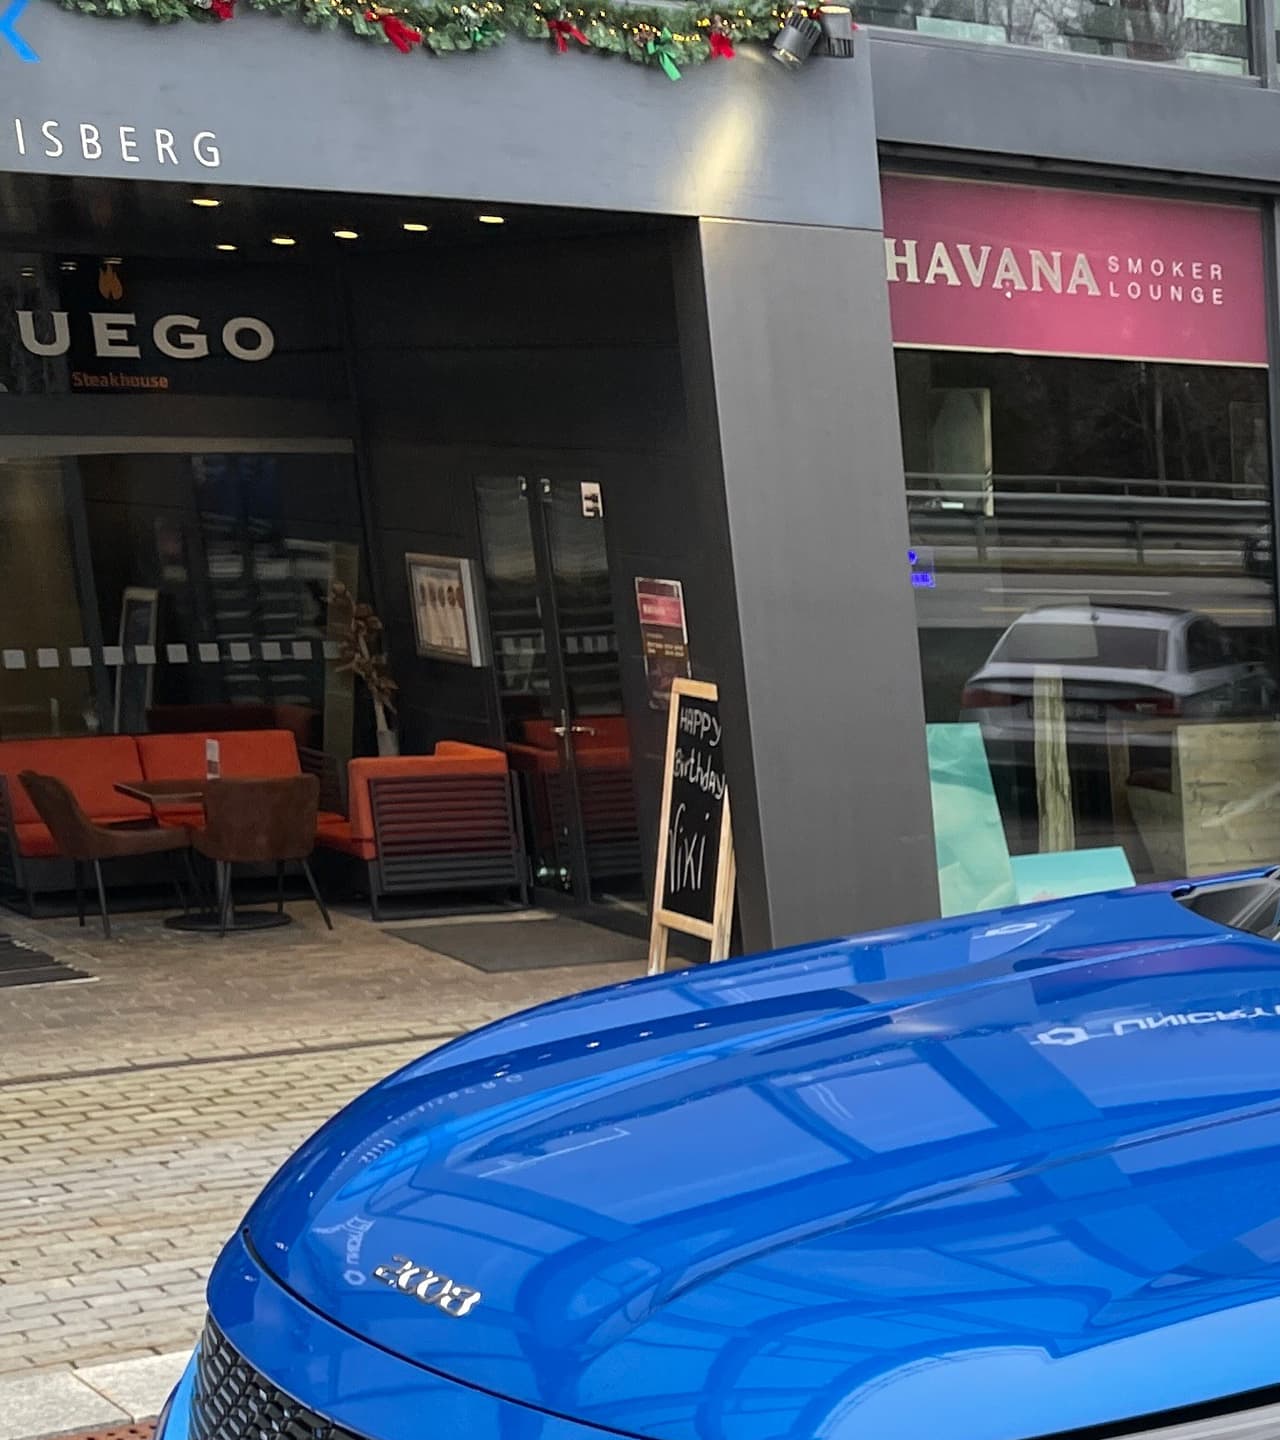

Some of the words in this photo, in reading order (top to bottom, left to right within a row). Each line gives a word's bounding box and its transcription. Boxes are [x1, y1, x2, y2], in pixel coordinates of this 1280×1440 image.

[15, 118, 221, 168] ISBERG
[884, 237, 1102, 297] HAVANA
[1108, 255, 1223, 281] SMOKER
[1109, 278, 1224, 305] LOUNGE
[15, 309, 275, 362] UEGO
[71, 371, 169, 390] Steakhouse
